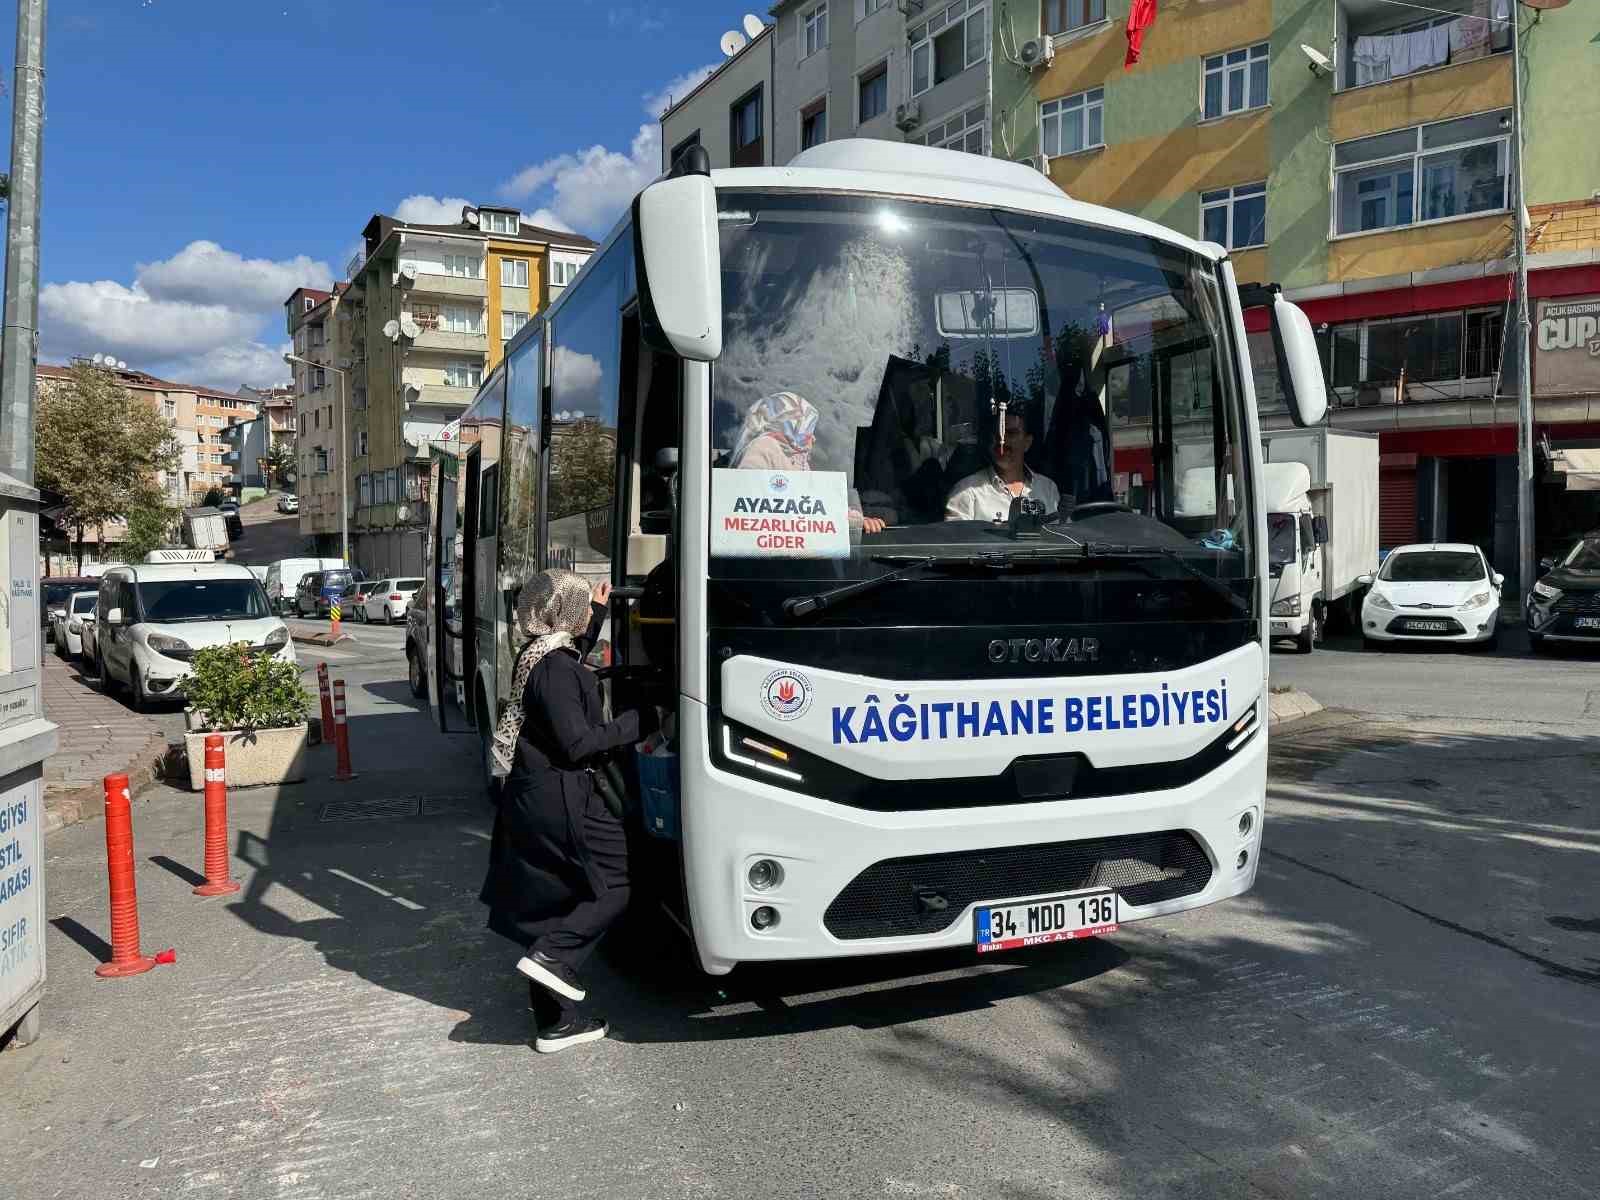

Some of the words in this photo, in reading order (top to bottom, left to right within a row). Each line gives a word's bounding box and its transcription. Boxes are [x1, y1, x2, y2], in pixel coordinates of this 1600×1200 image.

[1538, 316, 1600, 350] CUP
[733, 496, 826, 515] AYAZAĞA
[724, 516, 837, 533] MEZARLIĞINA
[757, 534, 805, 549] GİDER
[988, 638, 1099, 662] OTOKAR
[832, 692, 1054, 744] KÂĞITHANE
[1065, 679, 1228, 732] BELEDİYESİ
[0, 796, 26, 833] GİYSİ
[0, 866, 31, 904] ARASI
[2, 917, 26, 951] SIFIR
[981, 929, 990, 937] TR
[992, 910, 1016, 938] 34
[1028, 904, 1065, 933] MDD
[1078, 897, 1112, 925] 136
[1024, 935, 1050, 946] MKC
